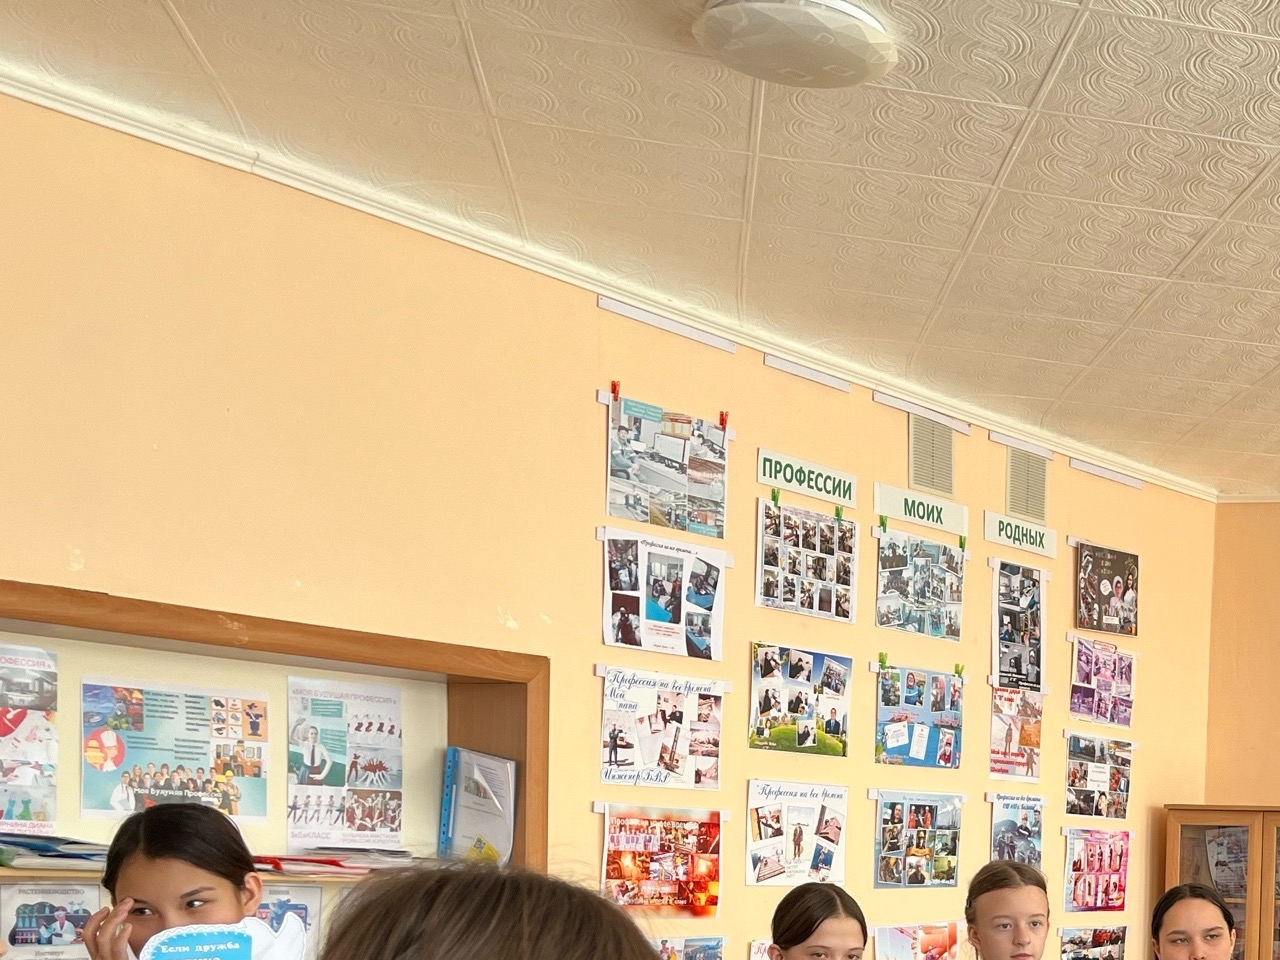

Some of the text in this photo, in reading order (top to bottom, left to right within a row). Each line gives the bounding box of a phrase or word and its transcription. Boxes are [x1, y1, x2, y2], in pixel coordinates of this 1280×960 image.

[762, 456, 852, 501] ПРОФЕССИИ
[903, 497, 944, 525] МОИХ
[998, 519, 1046, 549] РОДНЫХ
[0, 656, 46, 668] ОФЕССИЯ
[161, 941, 241, 953] Если дружба
